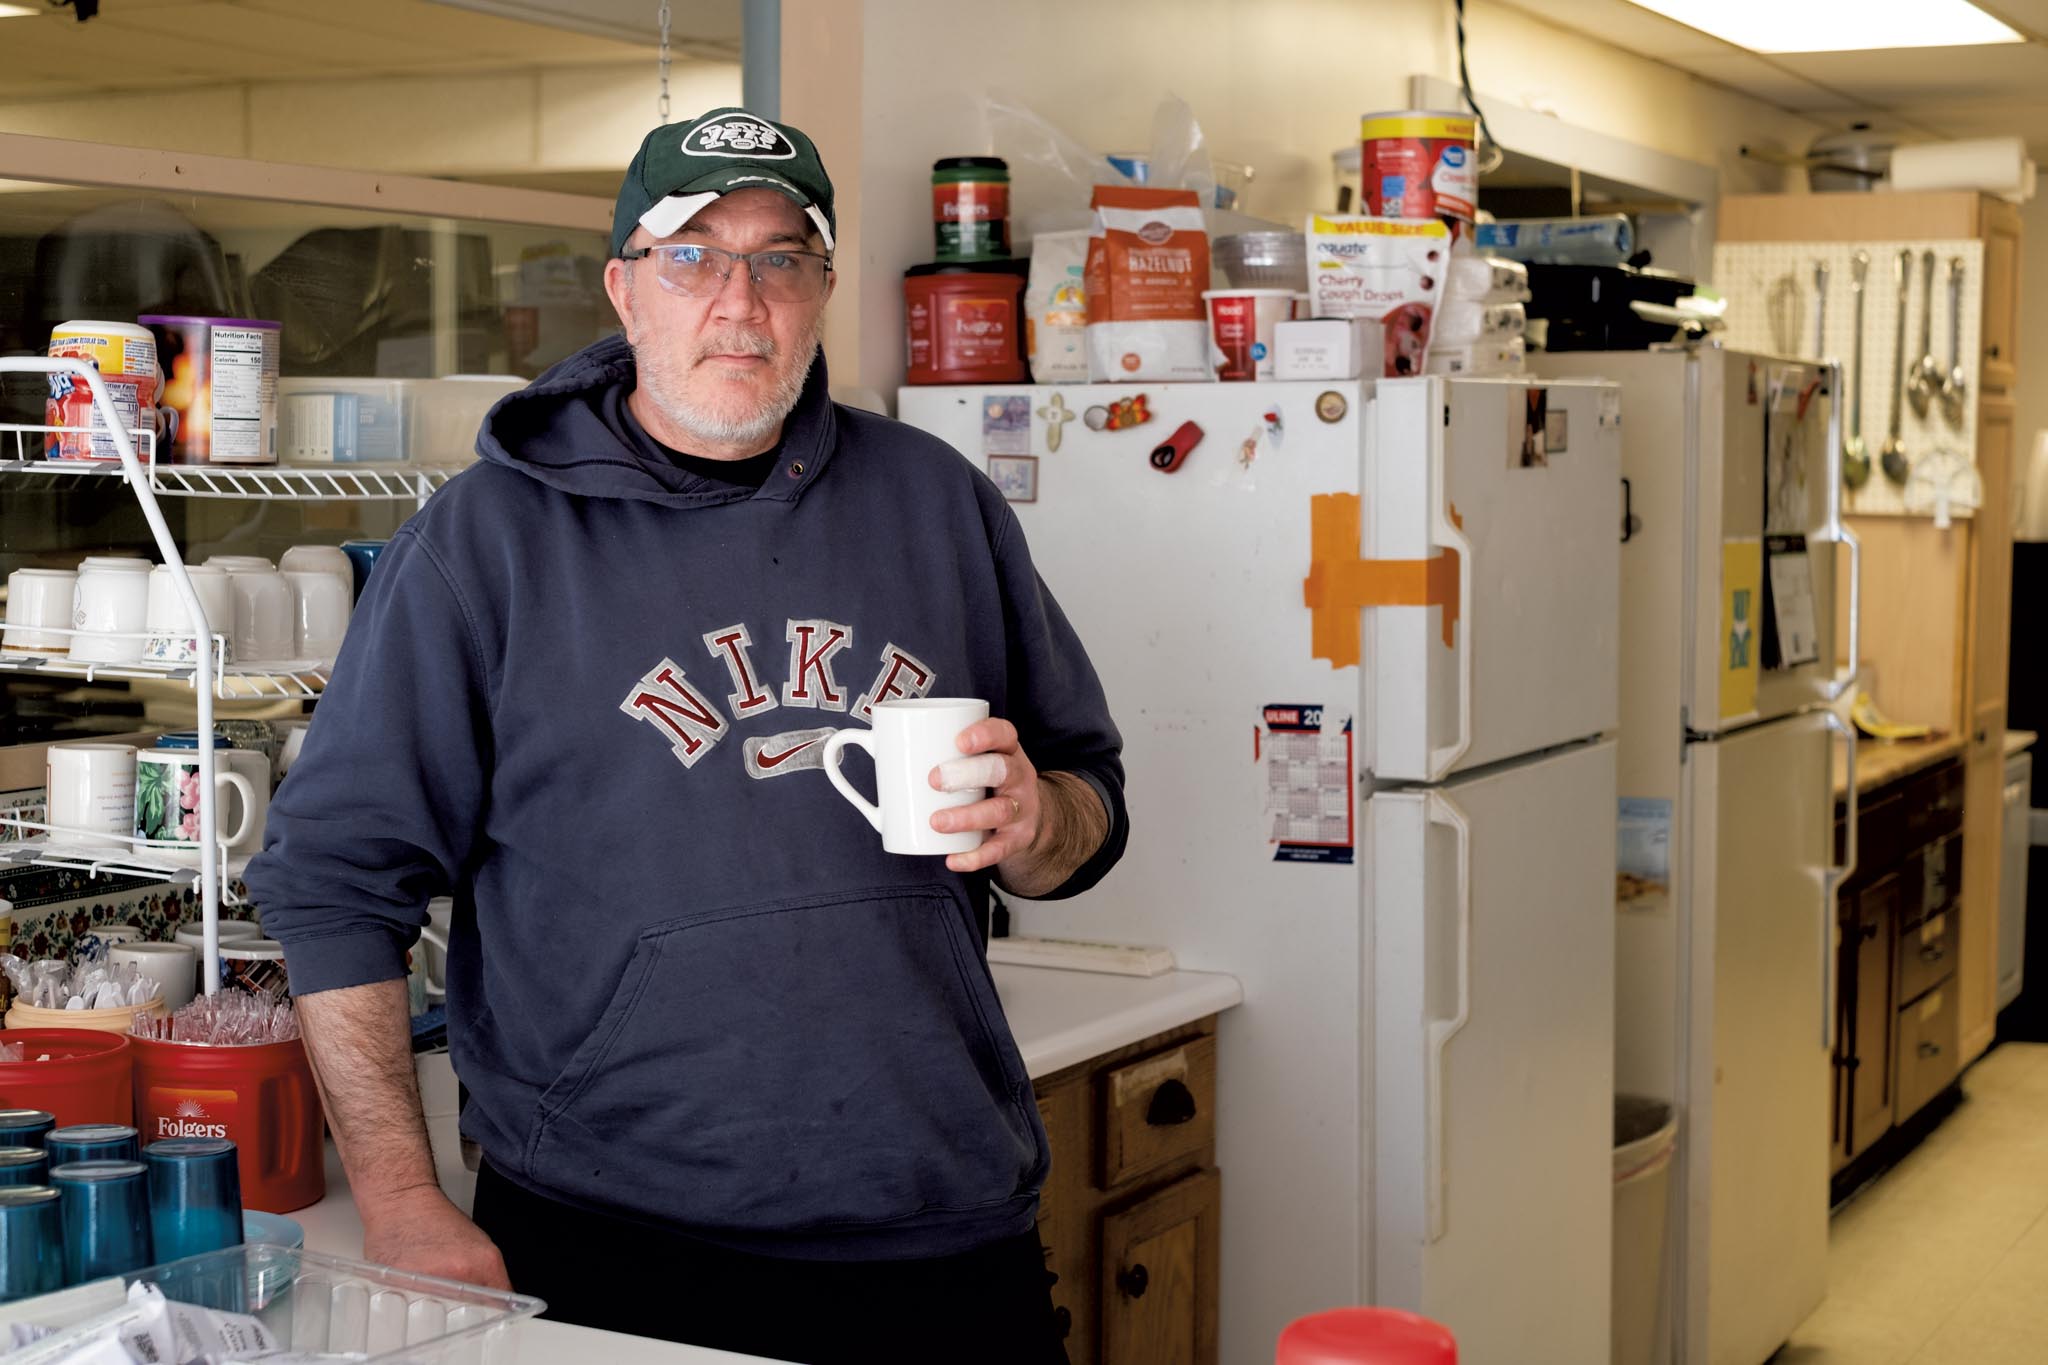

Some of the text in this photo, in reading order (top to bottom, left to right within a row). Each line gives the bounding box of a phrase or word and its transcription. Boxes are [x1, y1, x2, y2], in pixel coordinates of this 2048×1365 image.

[699, 122, 778, 150] JETS
[1335, 221, 1424, 235] VALUE SIZE
[1317, 241, 1369, 257] equate
[1128, 256, 1192, 273] HAZELNUT
[1318, 273, 1364, 288] Cherry
[1318, 289, 1405, 302] Cough Drops
[214, 331, 262, 341] Nutrition Facts
[250, 356, 261, 364] 150
[127, 403, 138, 412] 110
[619, 618, 936, 769] NIKE
[1265, 709, 1322, 726] ULINE 20
[157, 1116, 227, 1138] Folgers
